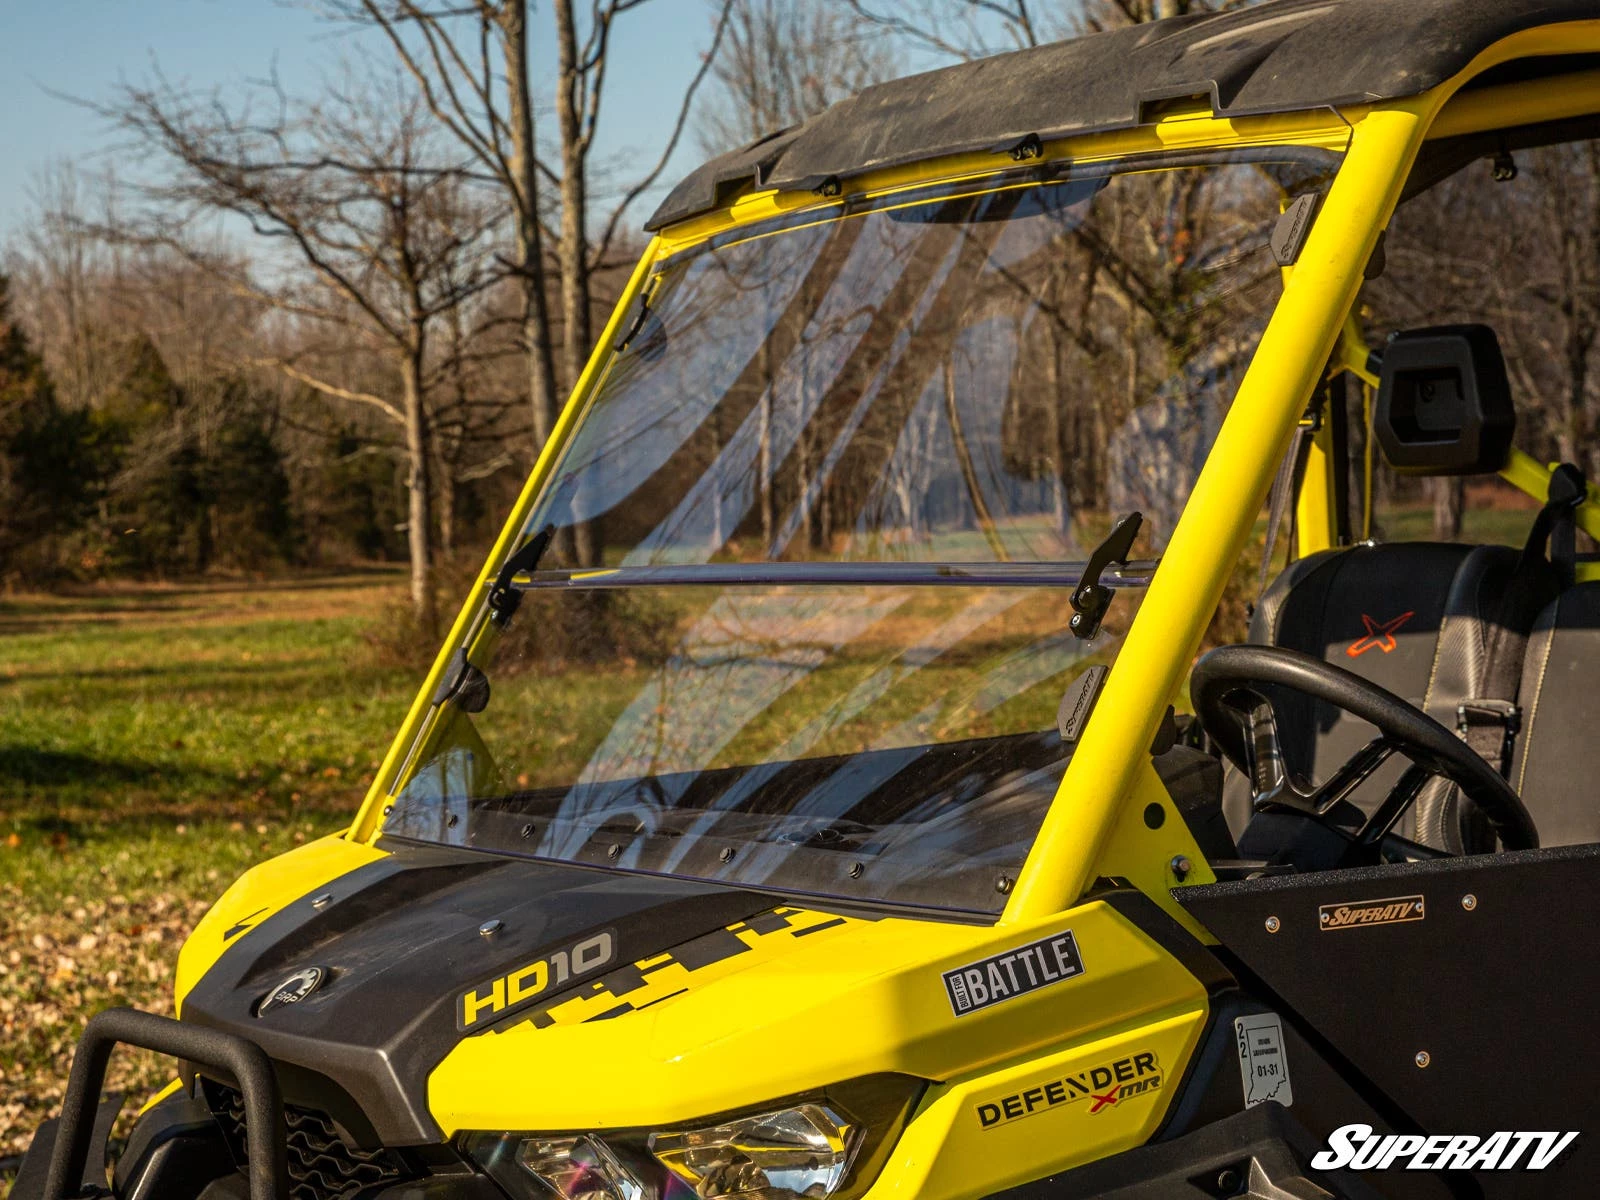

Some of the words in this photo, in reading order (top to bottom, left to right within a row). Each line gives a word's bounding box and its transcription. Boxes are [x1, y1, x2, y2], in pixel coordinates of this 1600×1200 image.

[1329, 902, 1415, 926] SUPERATV
[464, 932, 612, 1027] HD10
[964, 937, 1075, 1006] BATTLE
[274, 991, 298, 1003] BRP
[977, 1052, 1156, 1127] DEFENDER
[1257, 1063, 1278, 1077] 01-31
